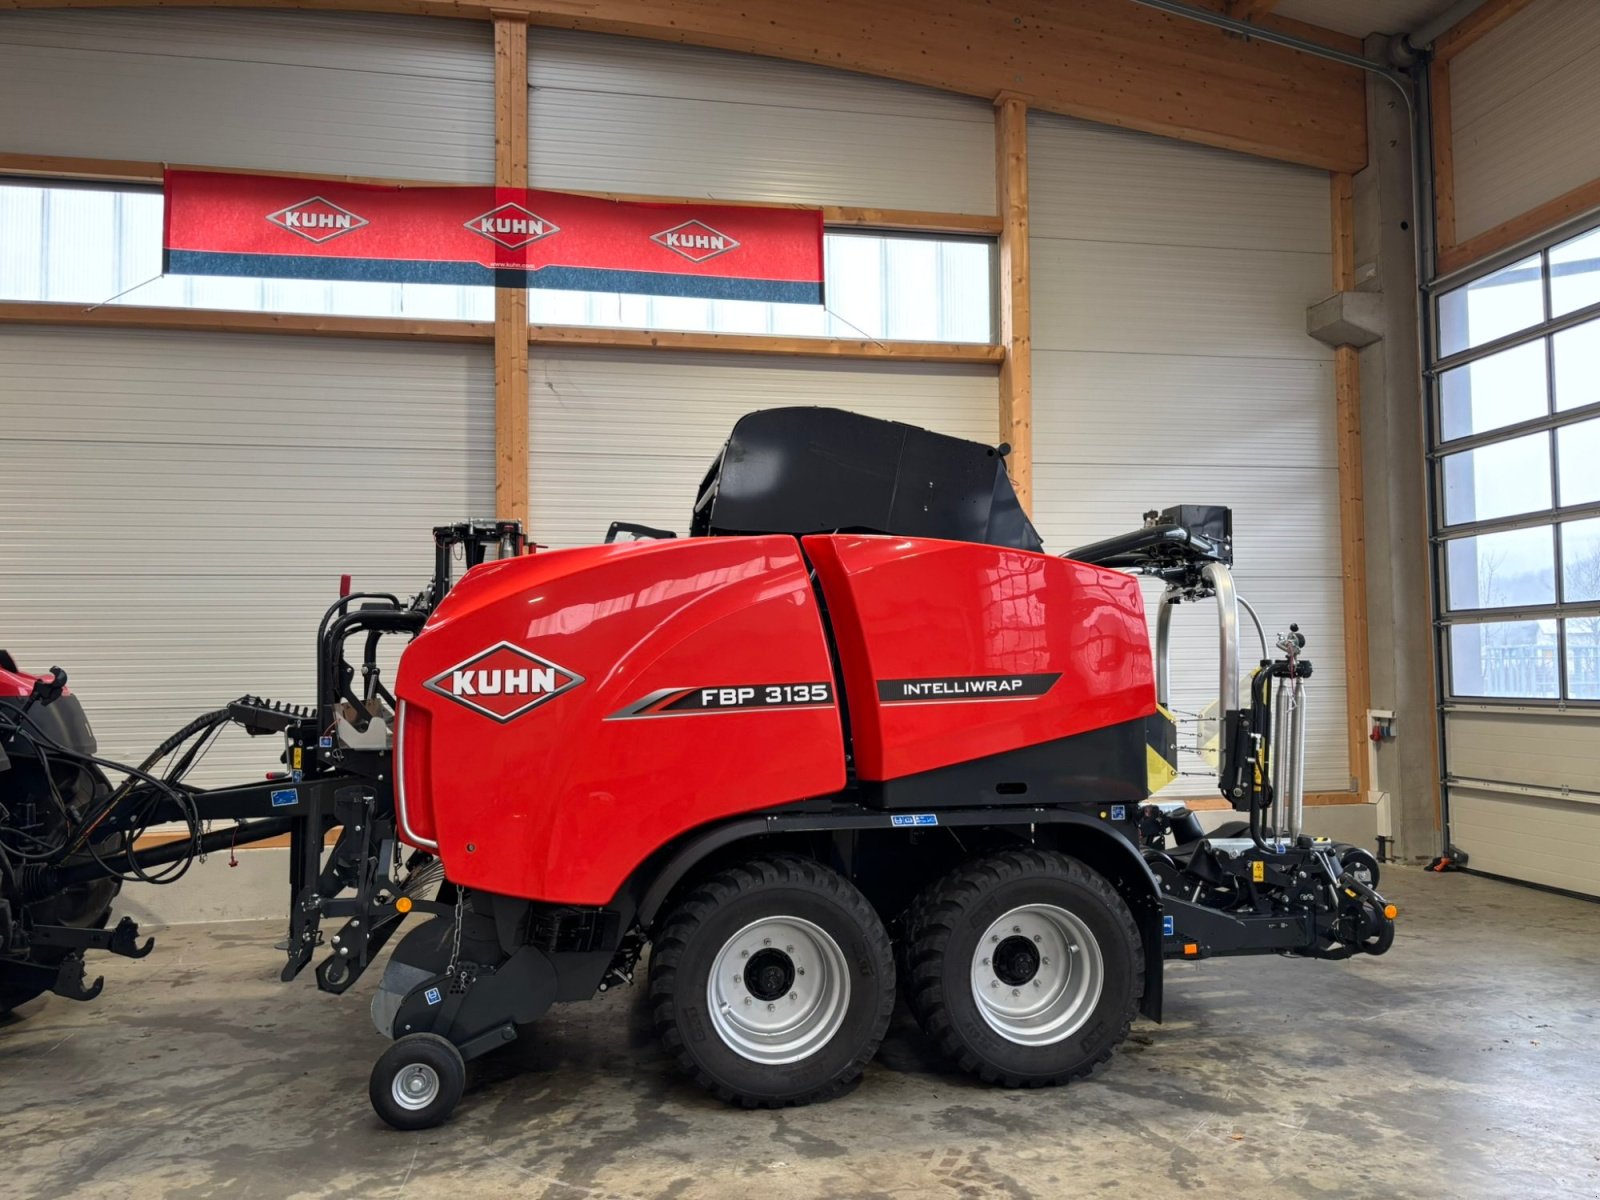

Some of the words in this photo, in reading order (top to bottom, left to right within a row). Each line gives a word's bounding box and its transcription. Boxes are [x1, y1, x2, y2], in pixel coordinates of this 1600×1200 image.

[285, 211, 351, 228] KUHN
[481, 217, 543, 235] KUHN
[666, 232, 724, 250] KUHN
[452, 667, 556, 696] KUHN
[903, 679, 1023, 696] INTELLIWRAP
[701, 687, 755, 706] FBP
[765, 684, 828, 703] 3135
